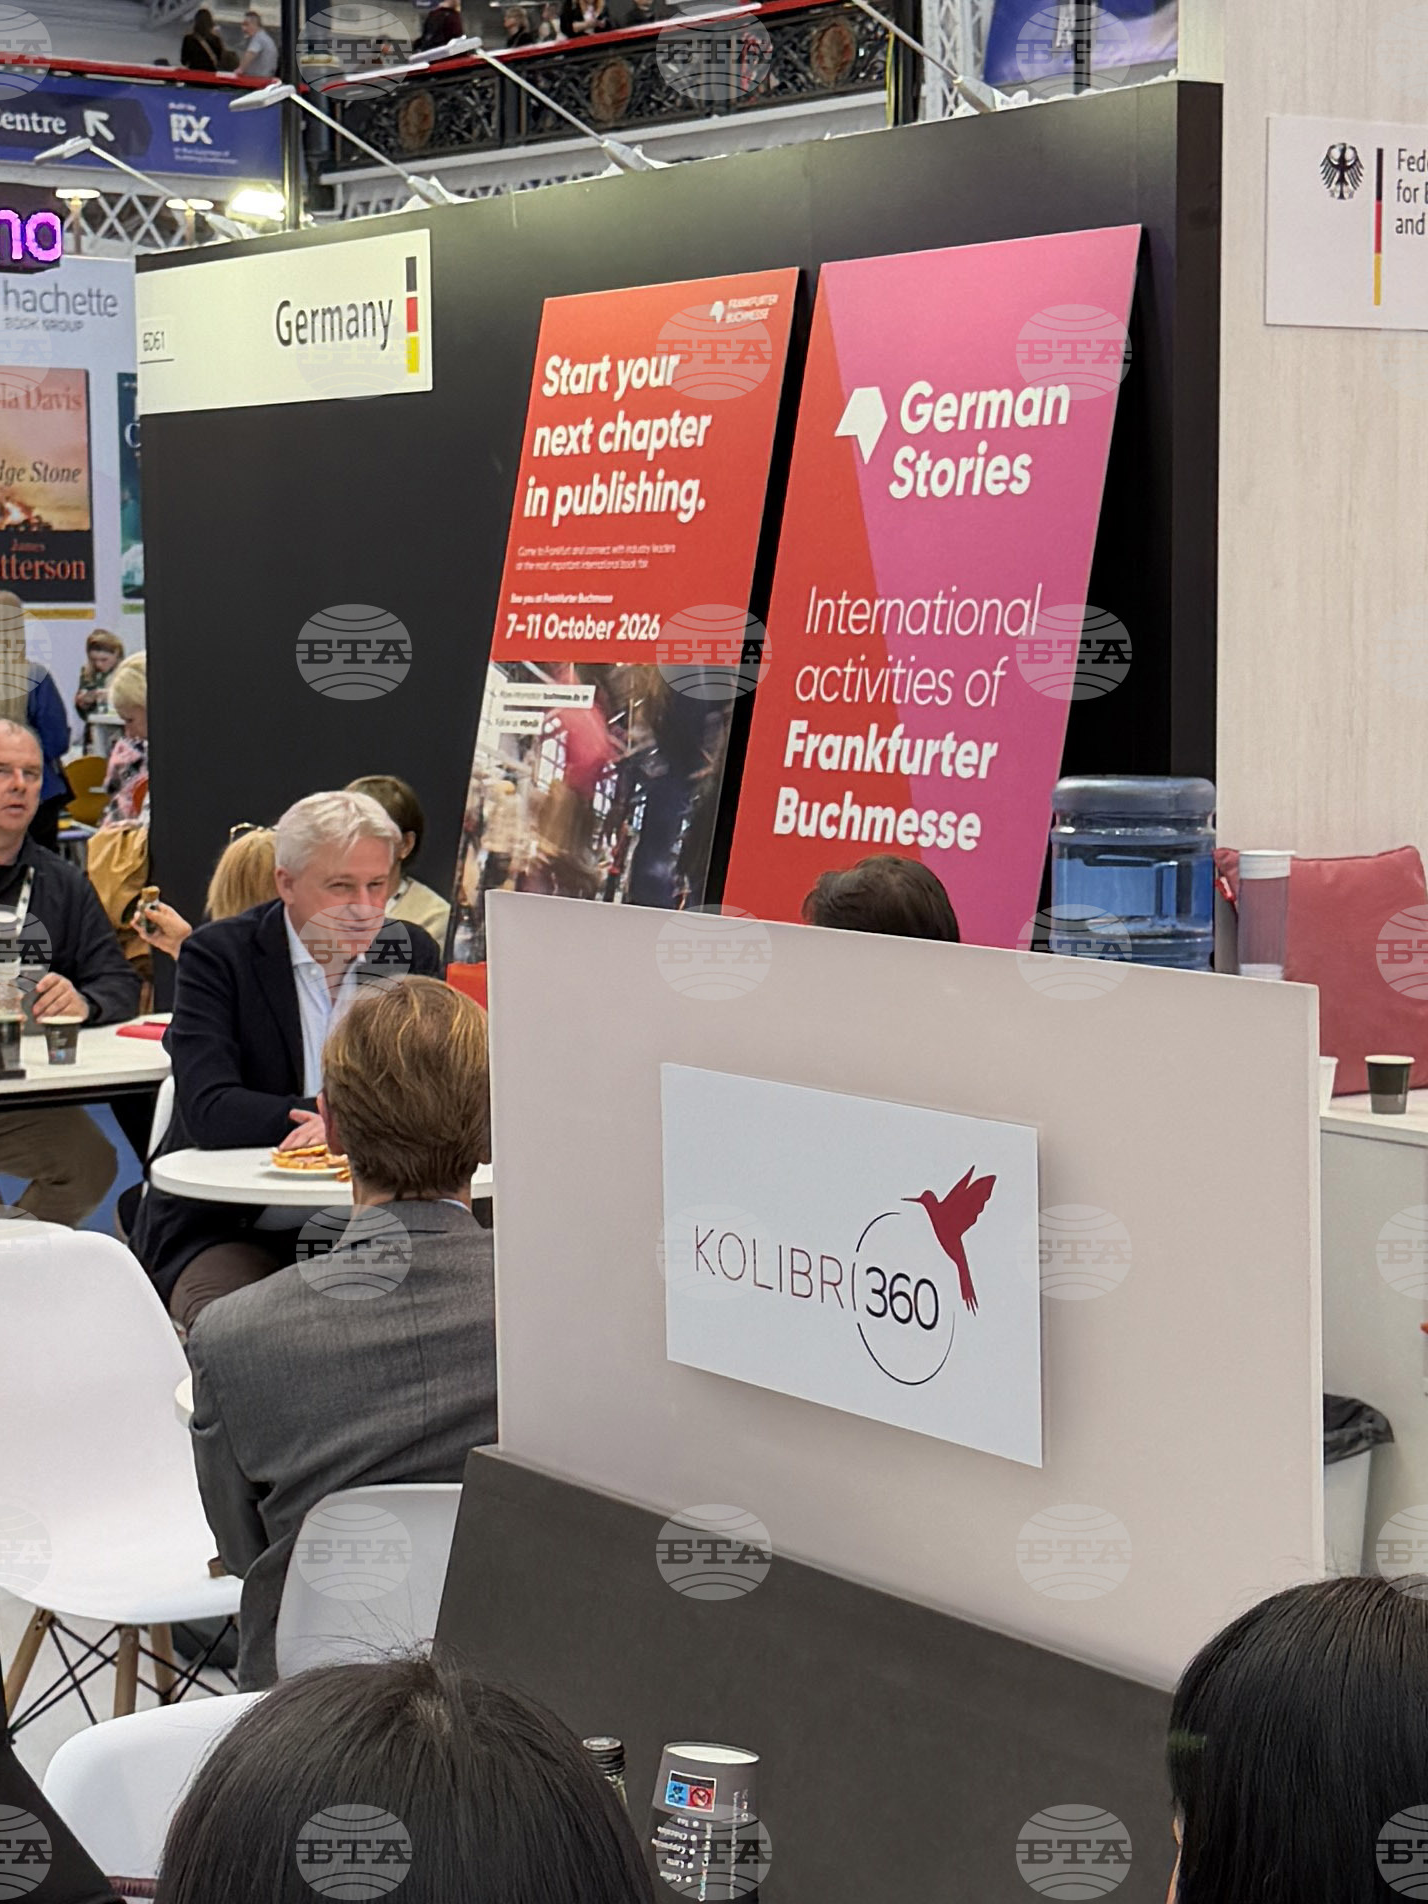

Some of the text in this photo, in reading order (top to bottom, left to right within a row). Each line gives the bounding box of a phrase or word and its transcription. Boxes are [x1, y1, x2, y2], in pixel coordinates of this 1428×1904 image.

[170, 113, 213, 145] RX
[1395, 178, 1420, 204] for
[1395, 212, 1426, 236] and
[3, 279, 119, 318] hachette
[274, 297, 394, 350] Germany
[25, 386, 83, 411] Davis
[541, 352, 682, 402] Start your
[899, 380, 1071, 434] German
[532, 409, 713, 462] next chapter
[29, 460, 83, 485] Stone
[888, 439, 1033, 500] Stories
[523, 467, 707, 528] in publishing.
[543, 612, 616, 641] October
[615, 612, 661, 641] 2026
[804, 582, 1043, 637] International
[794, 653, 1010, 708] activities of
[783, 719, 999, 779] Frankfurter
[772, 785, 983, 851] Buchmesse
